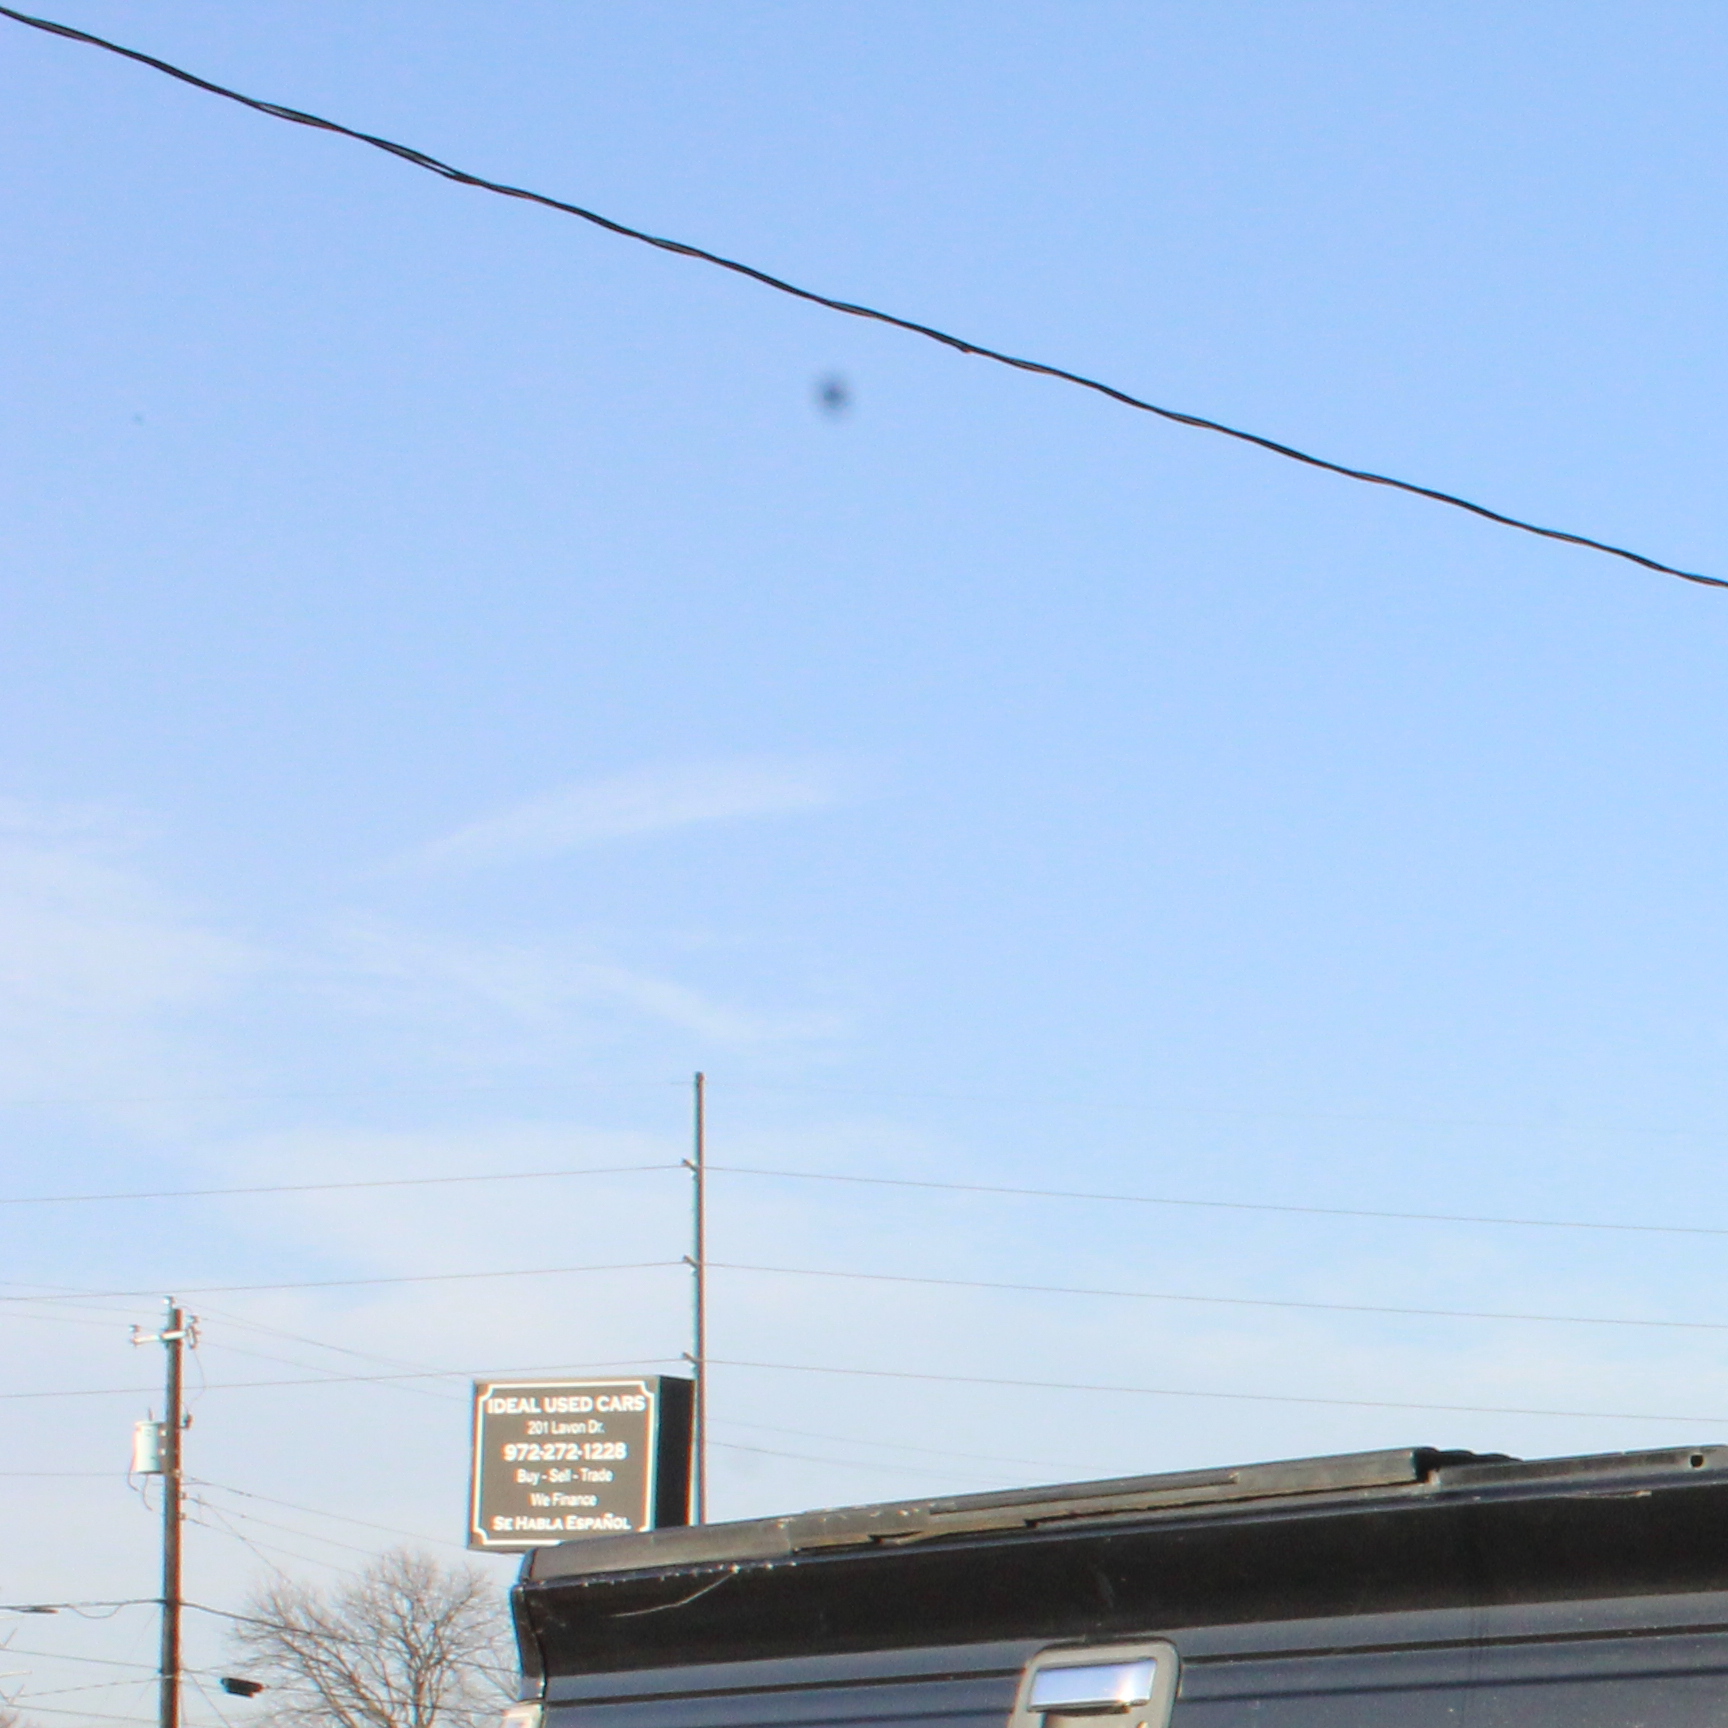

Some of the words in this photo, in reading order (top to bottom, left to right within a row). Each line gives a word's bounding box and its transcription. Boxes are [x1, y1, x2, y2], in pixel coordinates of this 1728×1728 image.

[487, 1398, 541, 1414] IDEAL
[544, 1397, 592, 1413] USED
[596, 1395, 646, 1412] CARS
[527, 1421, 548, 1435] 201
[551, 1420, 586, 1434] Lavon
[588, 1419, 605, 1433] Dr.
[516, 1468, 540, 1485] Buy
[549, 1468, 572, 1482] Sell
[580, 1468, 614, 1482] Trade
[530, 1493, 550, 1507] We
[552, 1493, 597, 1507] Finance
